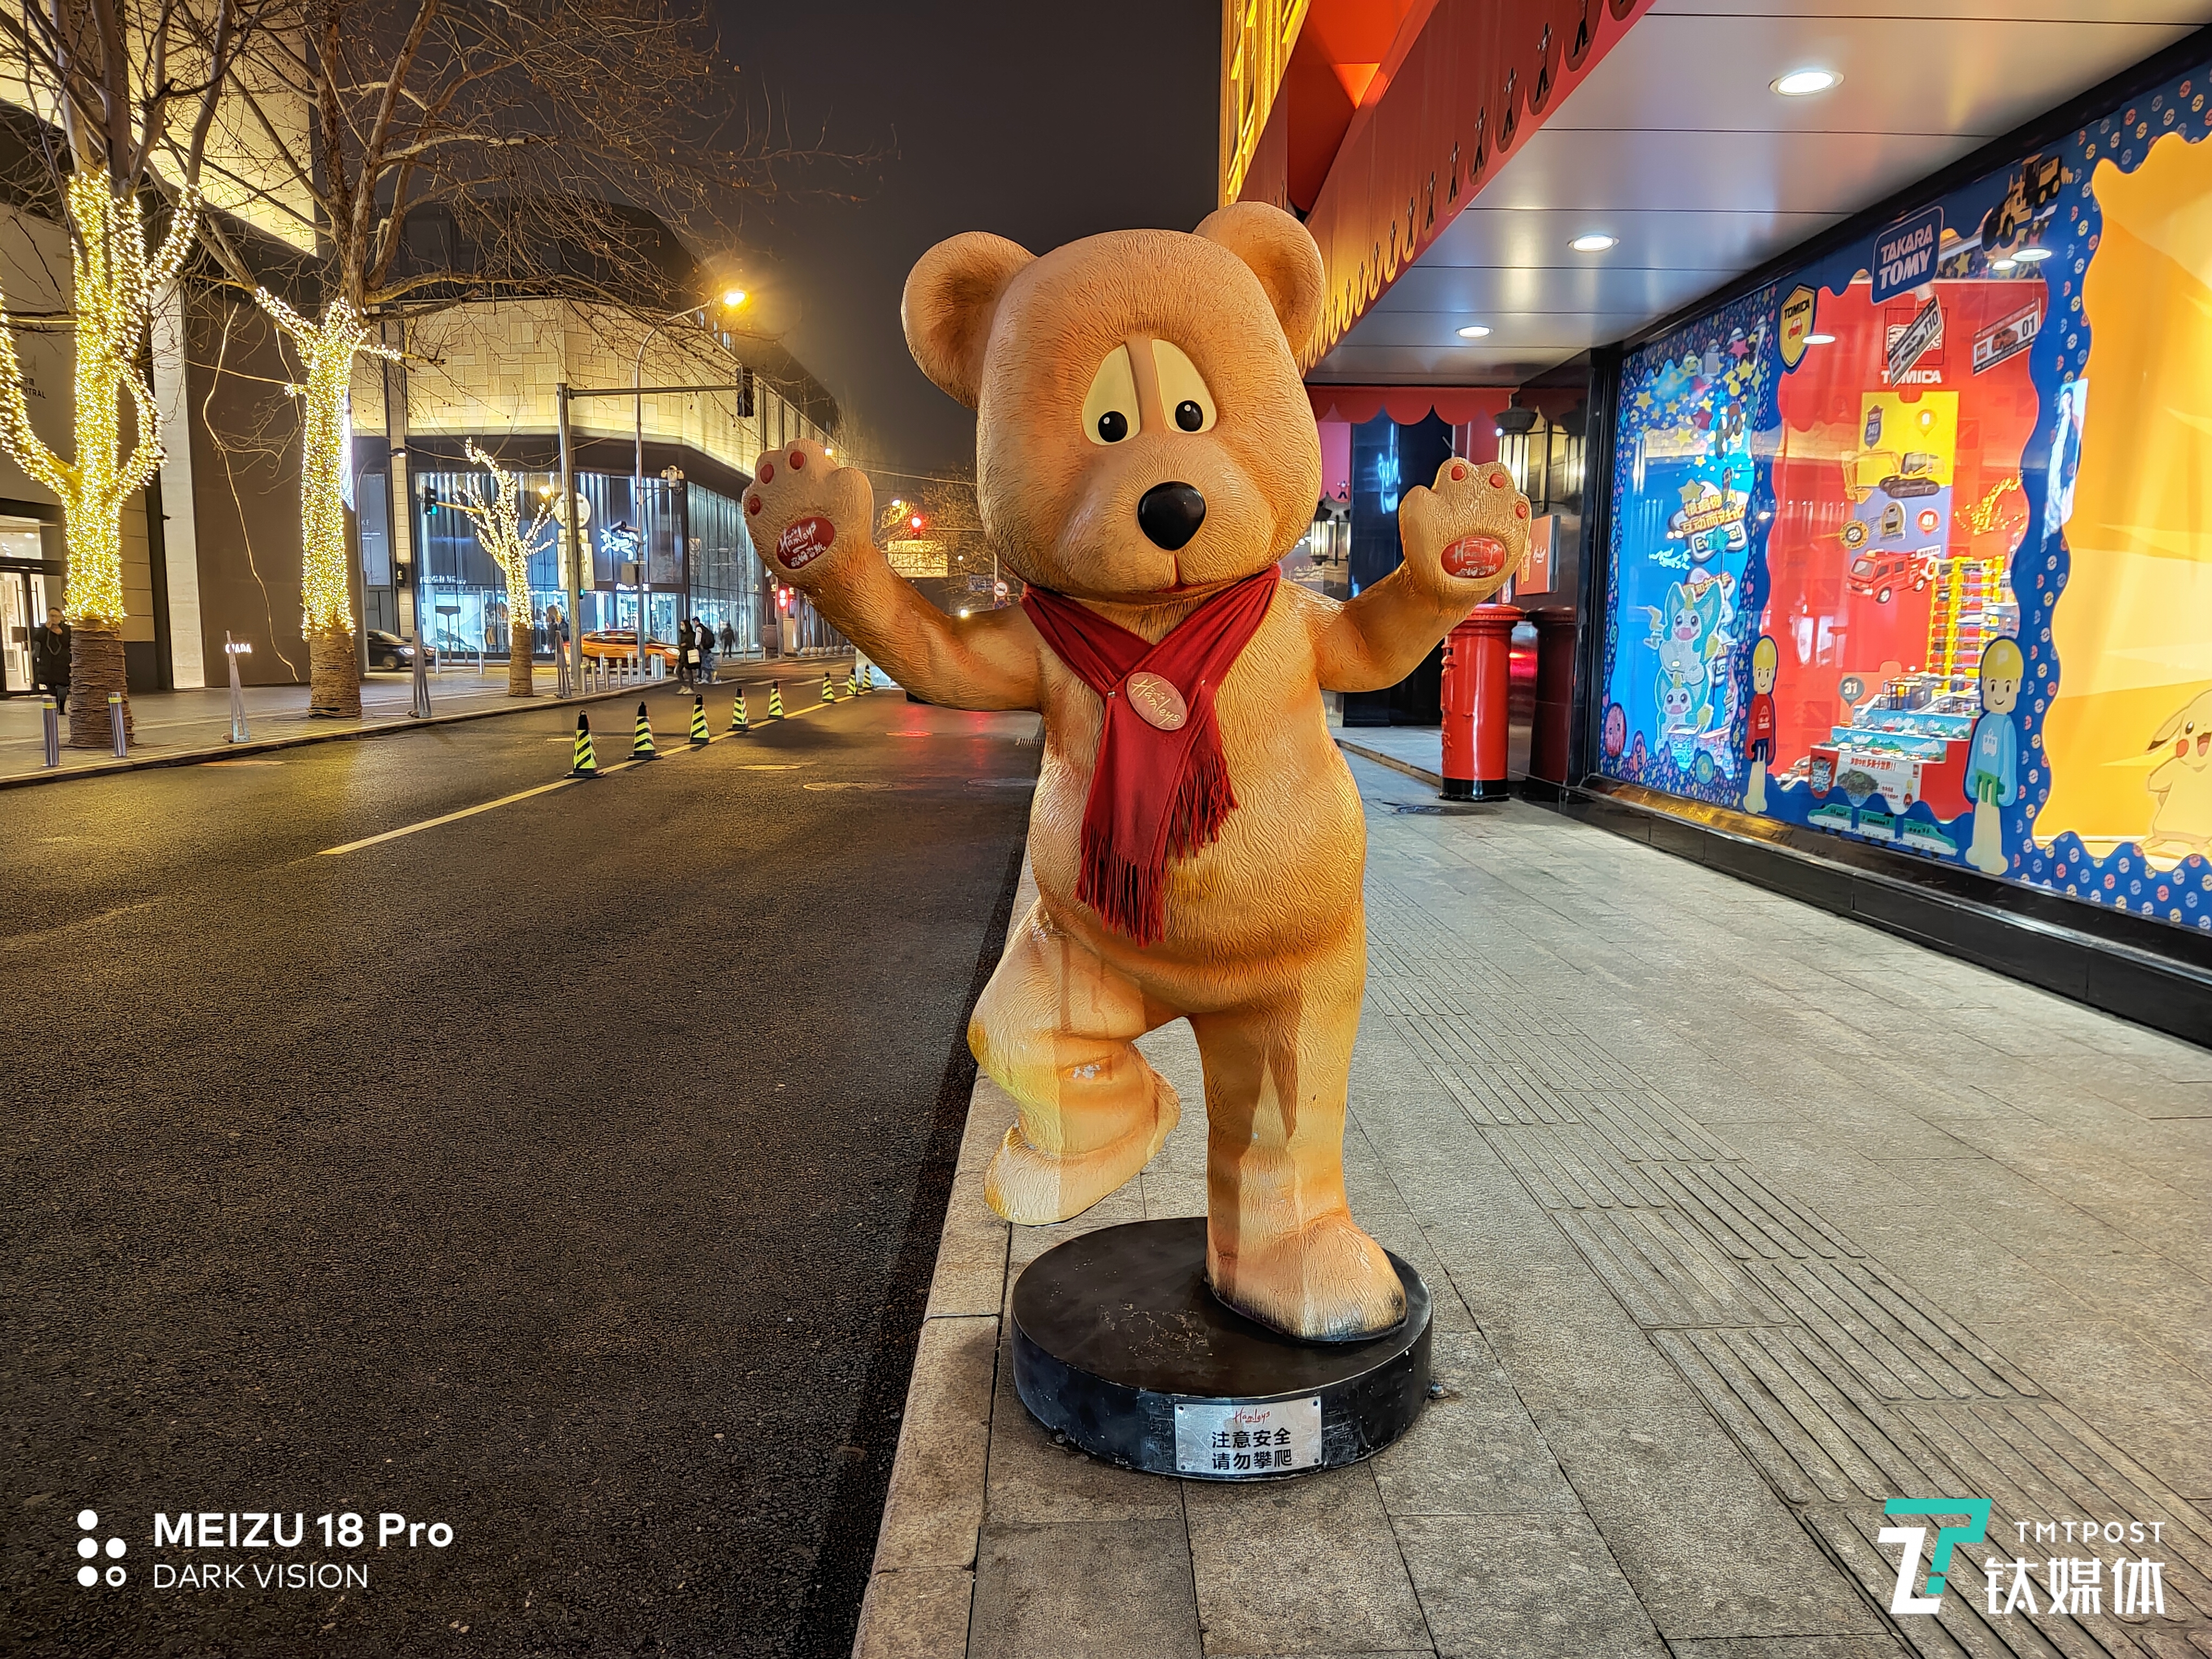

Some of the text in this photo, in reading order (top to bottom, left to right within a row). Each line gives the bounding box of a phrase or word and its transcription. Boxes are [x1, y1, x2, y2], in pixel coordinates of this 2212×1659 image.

[1881, 223, 1933, 265] TAKARA
[1879, 246, 1932, 290] TOMY
[1784, 299, 1810, 320] TOMICA
[1923, 311, 1939, 335] 110
[2022, 315, 2035, 337] 01
[1881, 370, 1942, 384] TMICA
[780, 521, 816, 556] Hamleys
[1844, 682, 1857, 694] 31
[1131, 678, 1180, 725] Hamleys
[1233, 1407, 1270, 1424] Hamleys
[1212, 1427, 1291, 1449] 注意安全
[1212, 1449, 1292, 1470] 请勿攀爬
